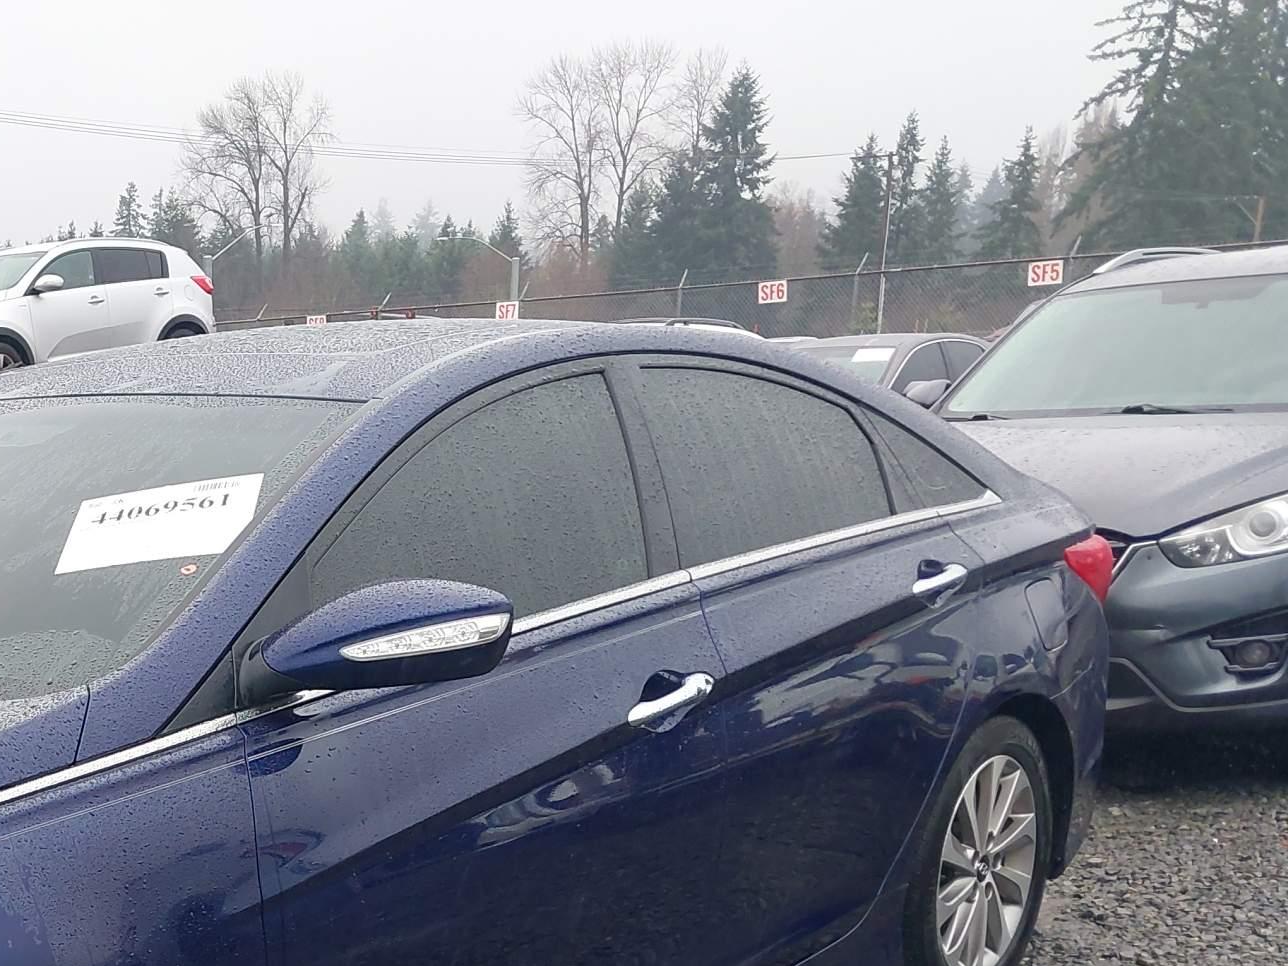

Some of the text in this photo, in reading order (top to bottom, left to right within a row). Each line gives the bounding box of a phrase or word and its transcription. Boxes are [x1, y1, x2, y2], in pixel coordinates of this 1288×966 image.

[1031, 263, 1060, 283] SF5
[760, 283, 785, 301] SF6
[498, 304, 516, 319] SF7
[91, 493, 230, 524] 44069561
